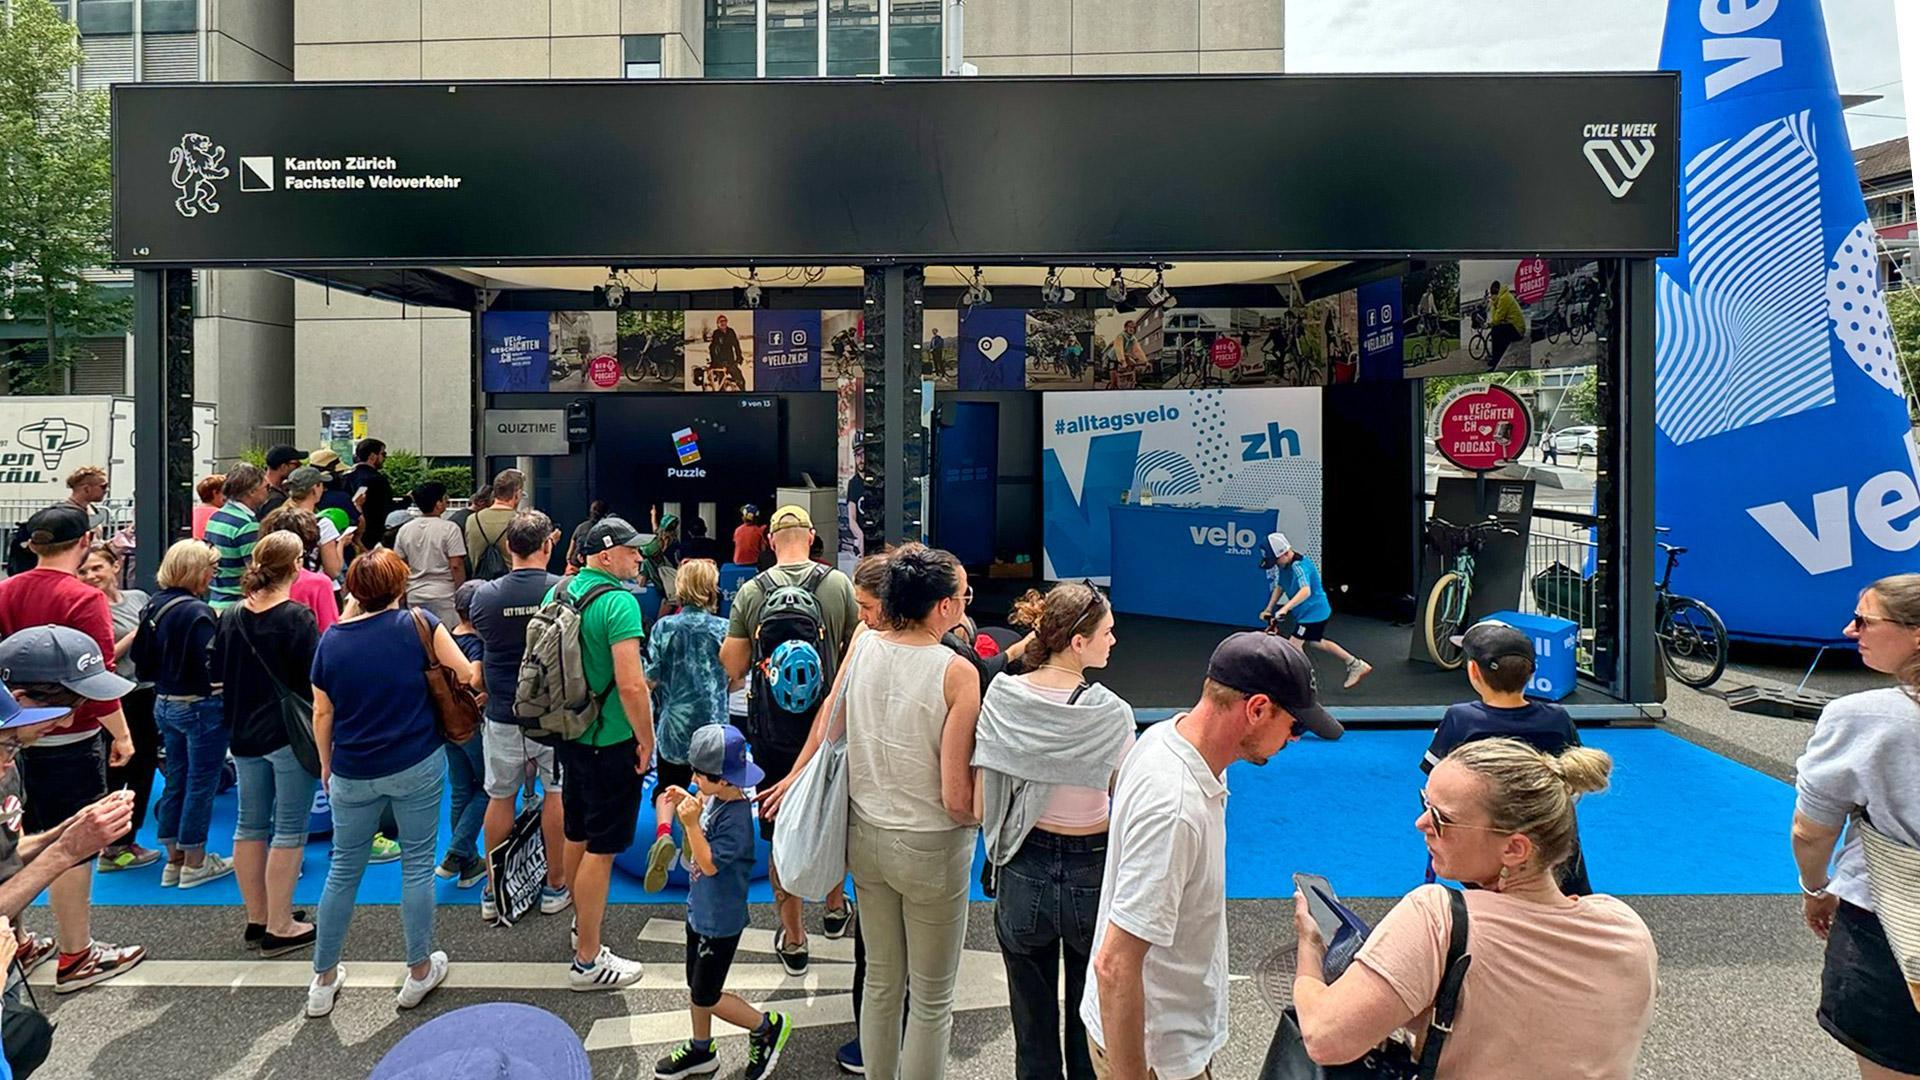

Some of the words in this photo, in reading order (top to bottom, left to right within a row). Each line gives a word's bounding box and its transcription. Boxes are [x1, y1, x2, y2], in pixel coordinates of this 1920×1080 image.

[1583, 123, 1619, 138] CYCLE
[1621, 123, 1658, 138] WEEK
[285, 157, 341, 170] Kanton
[345, 156, 396, 170] Zürich
[285, 175, 365, 189] Fachstelle
[368, 174, 461, 188] Veloverkehr
[139, 247, 150, 256] 43
[741, 400, 747, 408] 9
[763, 400, 772, 408] 13
[1468, 402, 1498, 415] VELO-
[1055, 405, 1180, 435] #alltagsvelo
[1452, 408, 1514, 421] GESCHICHTEN
[497, 423, 557, 434] QUIZTIME
[1461, 421, 1477, 433] .CH
[1241, 421, 1301, 462] zh
[1453, 441, 1496, 453] PODCAST
[0, 453, 34, 466] en
[667, 467, 707, 478] Puzzle
[1189, 522, 1257, 548] velo
[1225, 547, 1252, 556] .zh.ch
[505, 845, 546, 897] INHALT
